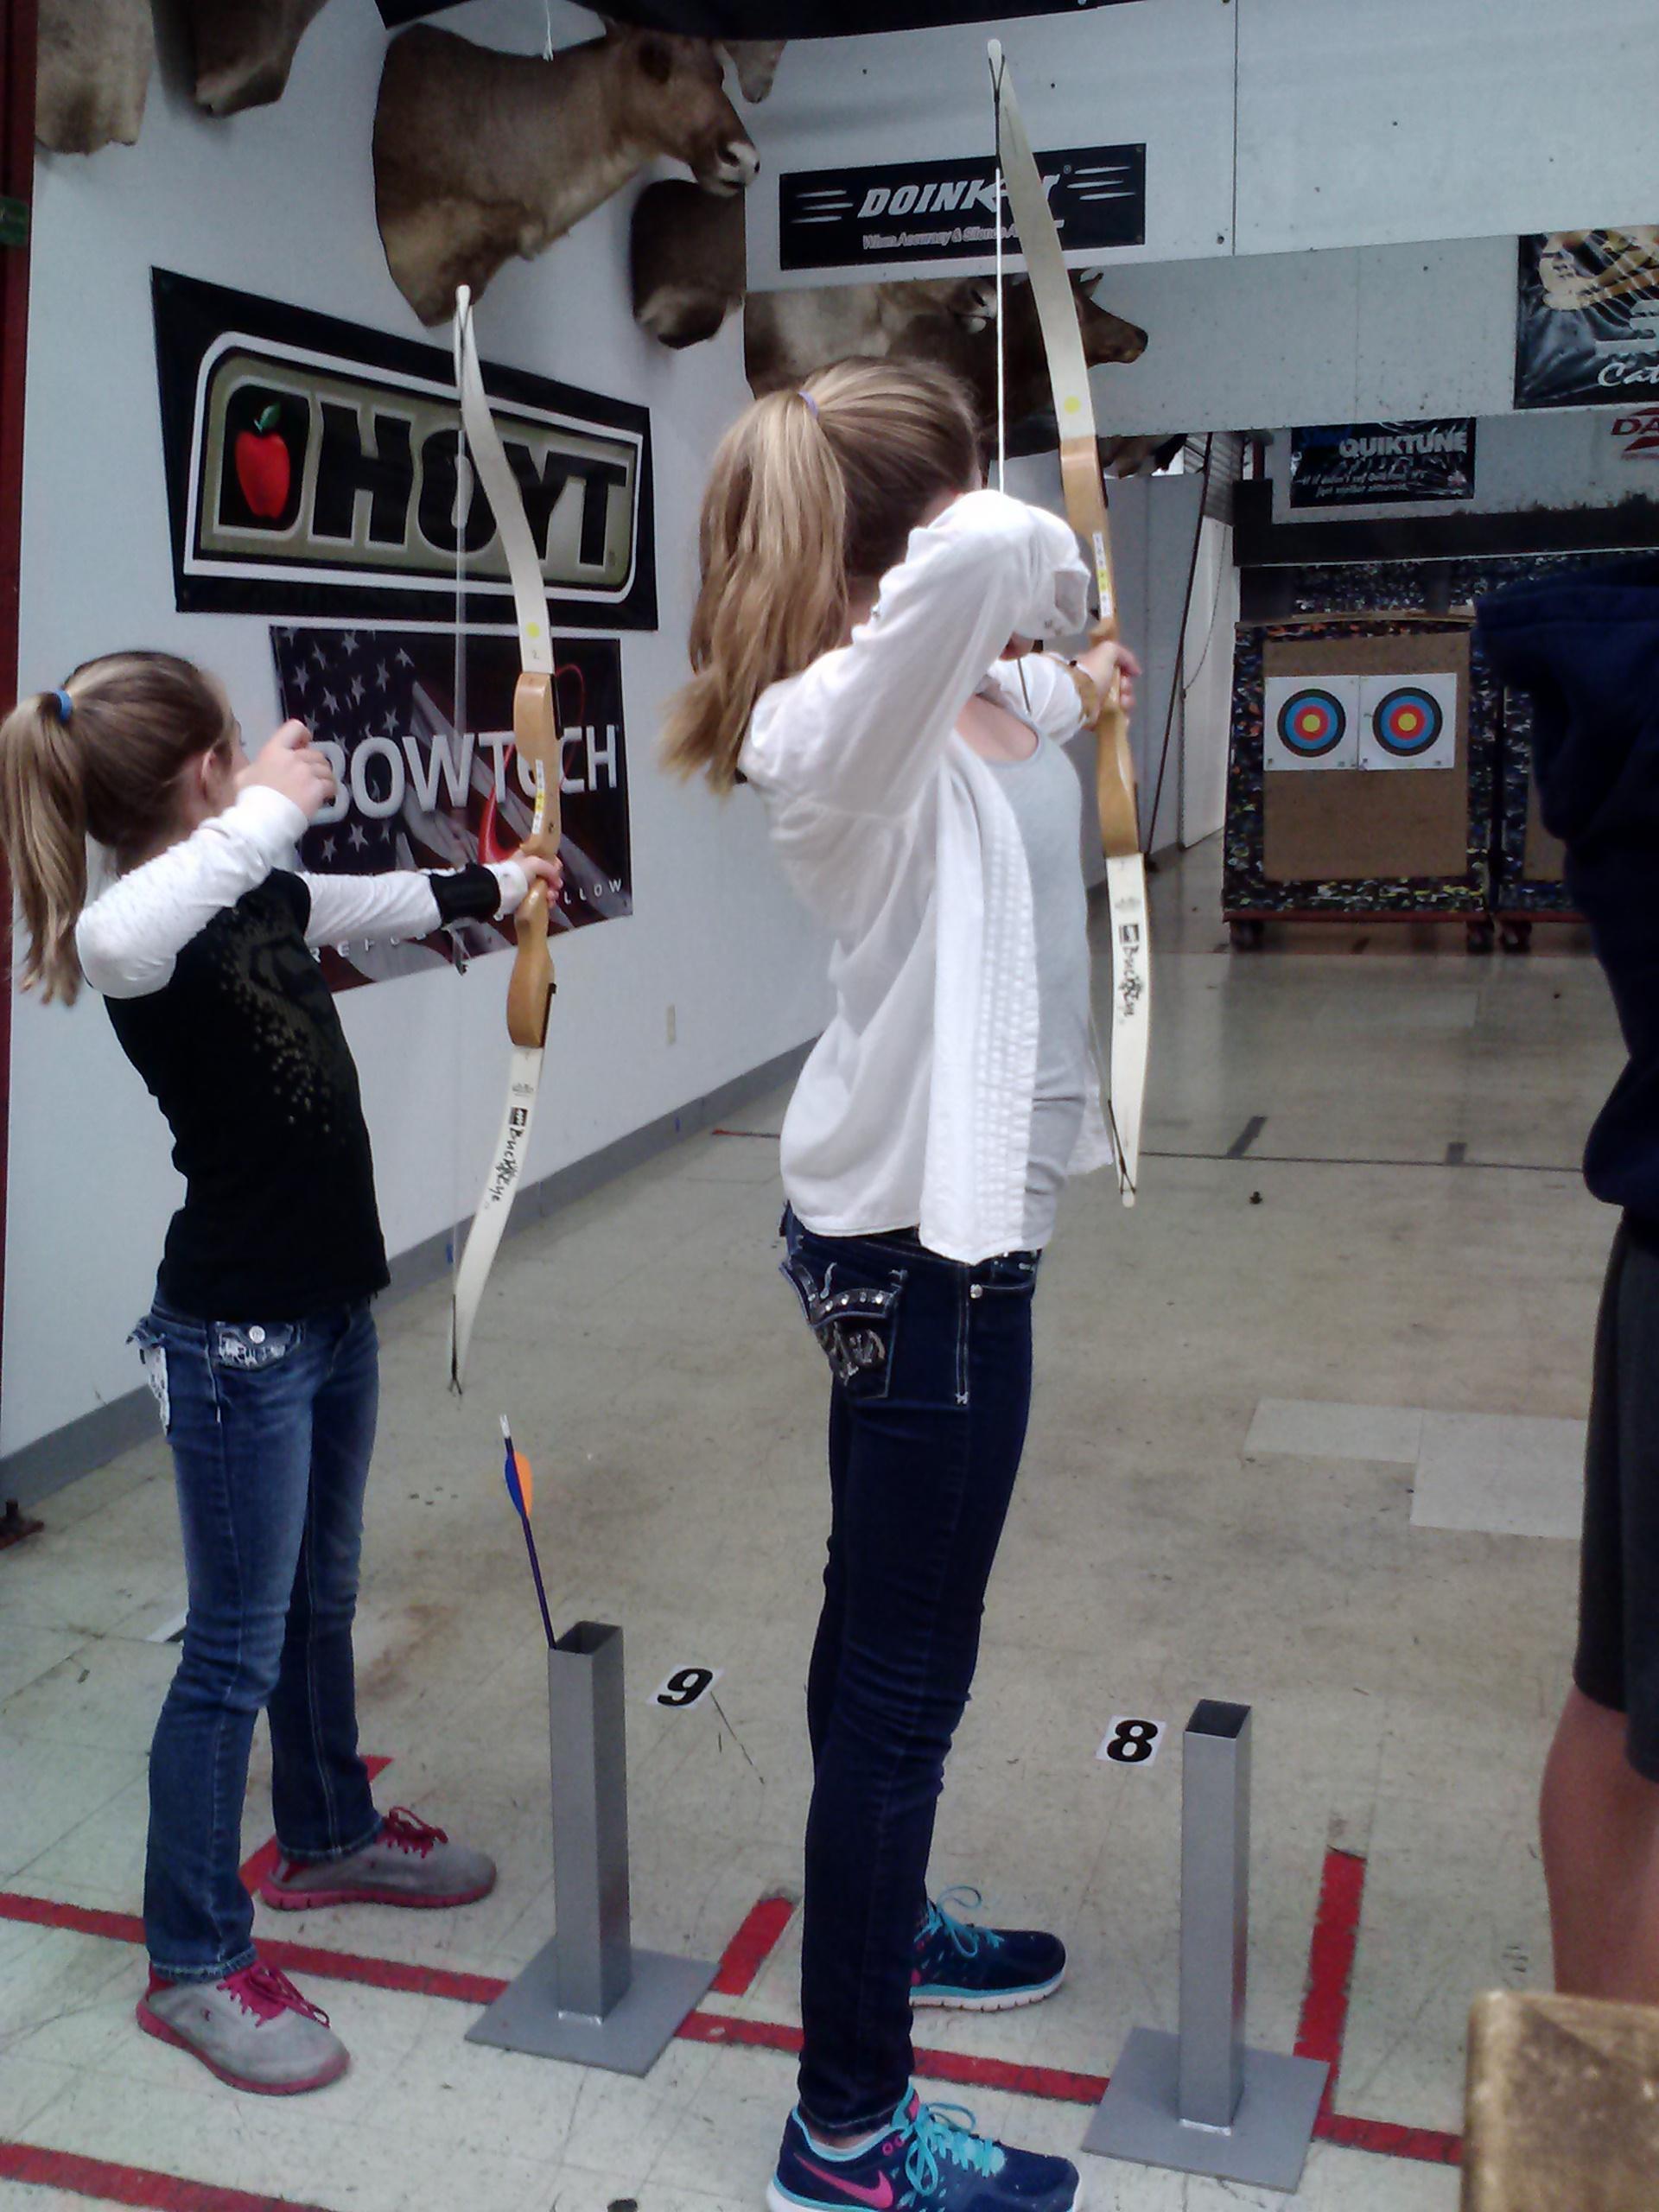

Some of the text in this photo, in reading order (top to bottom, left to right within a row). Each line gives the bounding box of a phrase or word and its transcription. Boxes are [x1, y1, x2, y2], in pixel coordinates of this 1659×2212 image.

[1338, 430, 1467, 459] QUIKTUNE
[311, 400, 627, 566] HOYT
[657, 1668, 714, 1707] 9
[1105, 1719, 1159, 1762] 8
